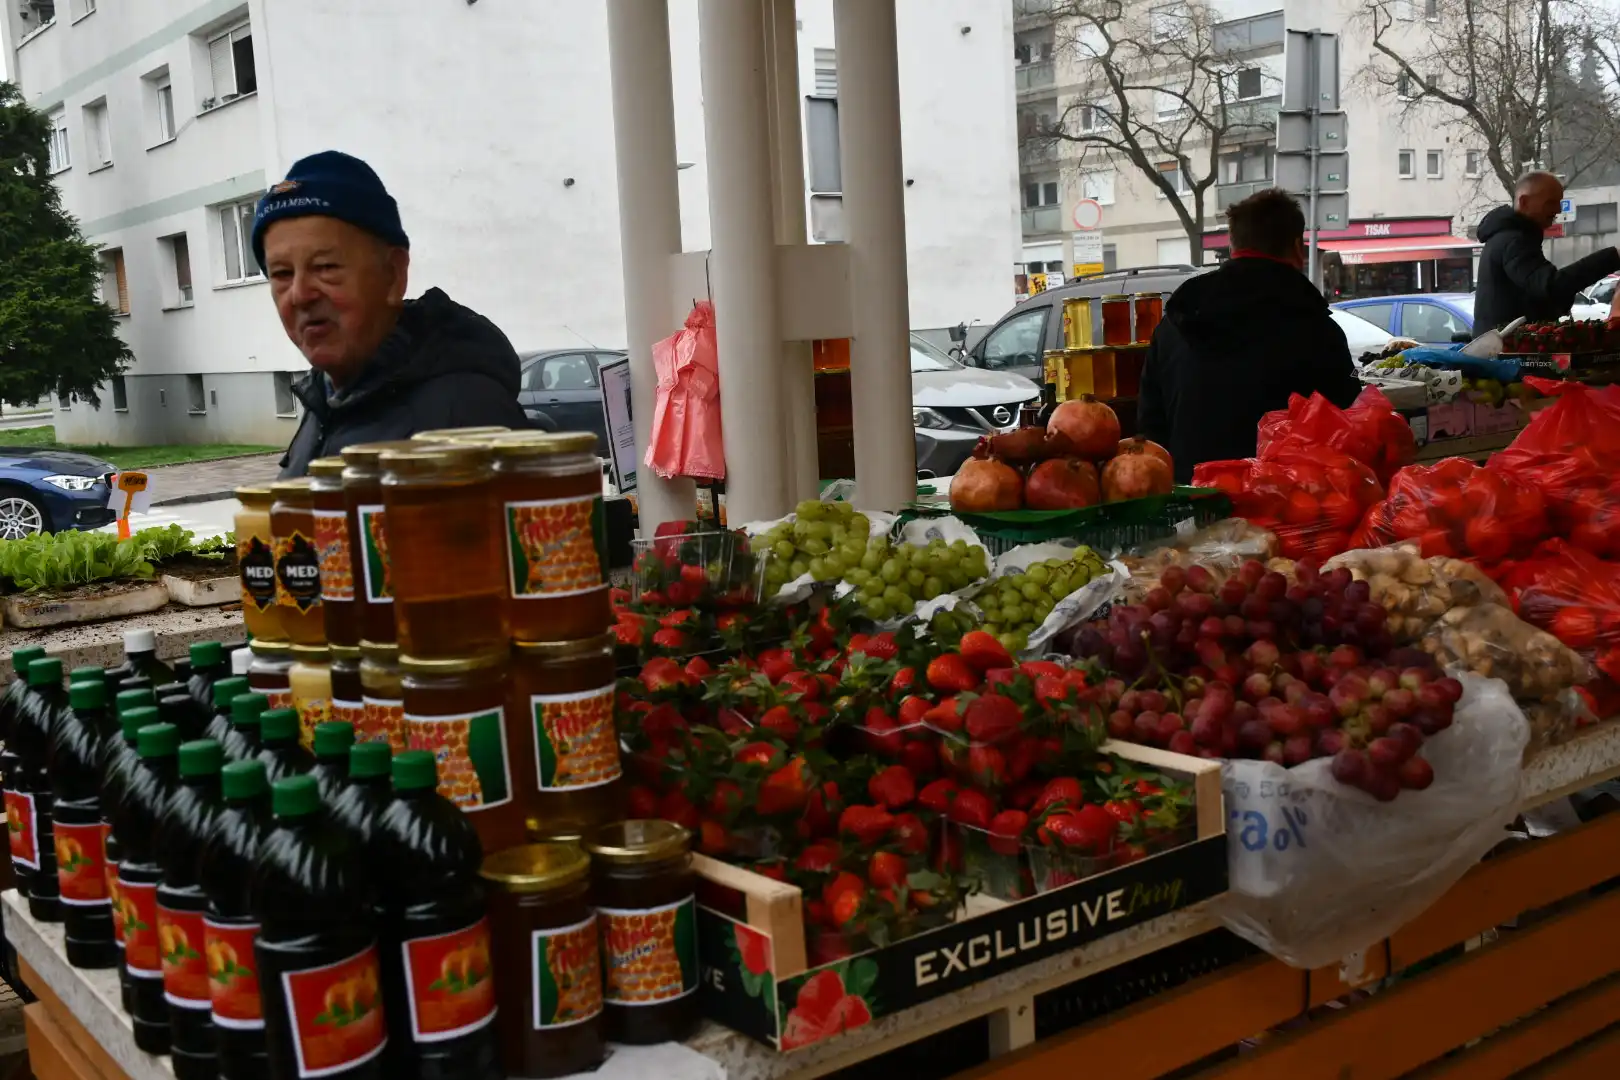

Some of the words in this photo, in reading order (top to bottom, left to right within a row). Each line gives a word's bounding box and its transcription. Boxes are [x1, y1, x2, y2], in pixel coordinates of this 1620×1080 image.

[1364, 224, 1390, 236] TISAK
[246, 566, 274, 578] MED
[286, 565, 318, 577] MED
[914, 888, 1126, 987] EXCLUSIVE
